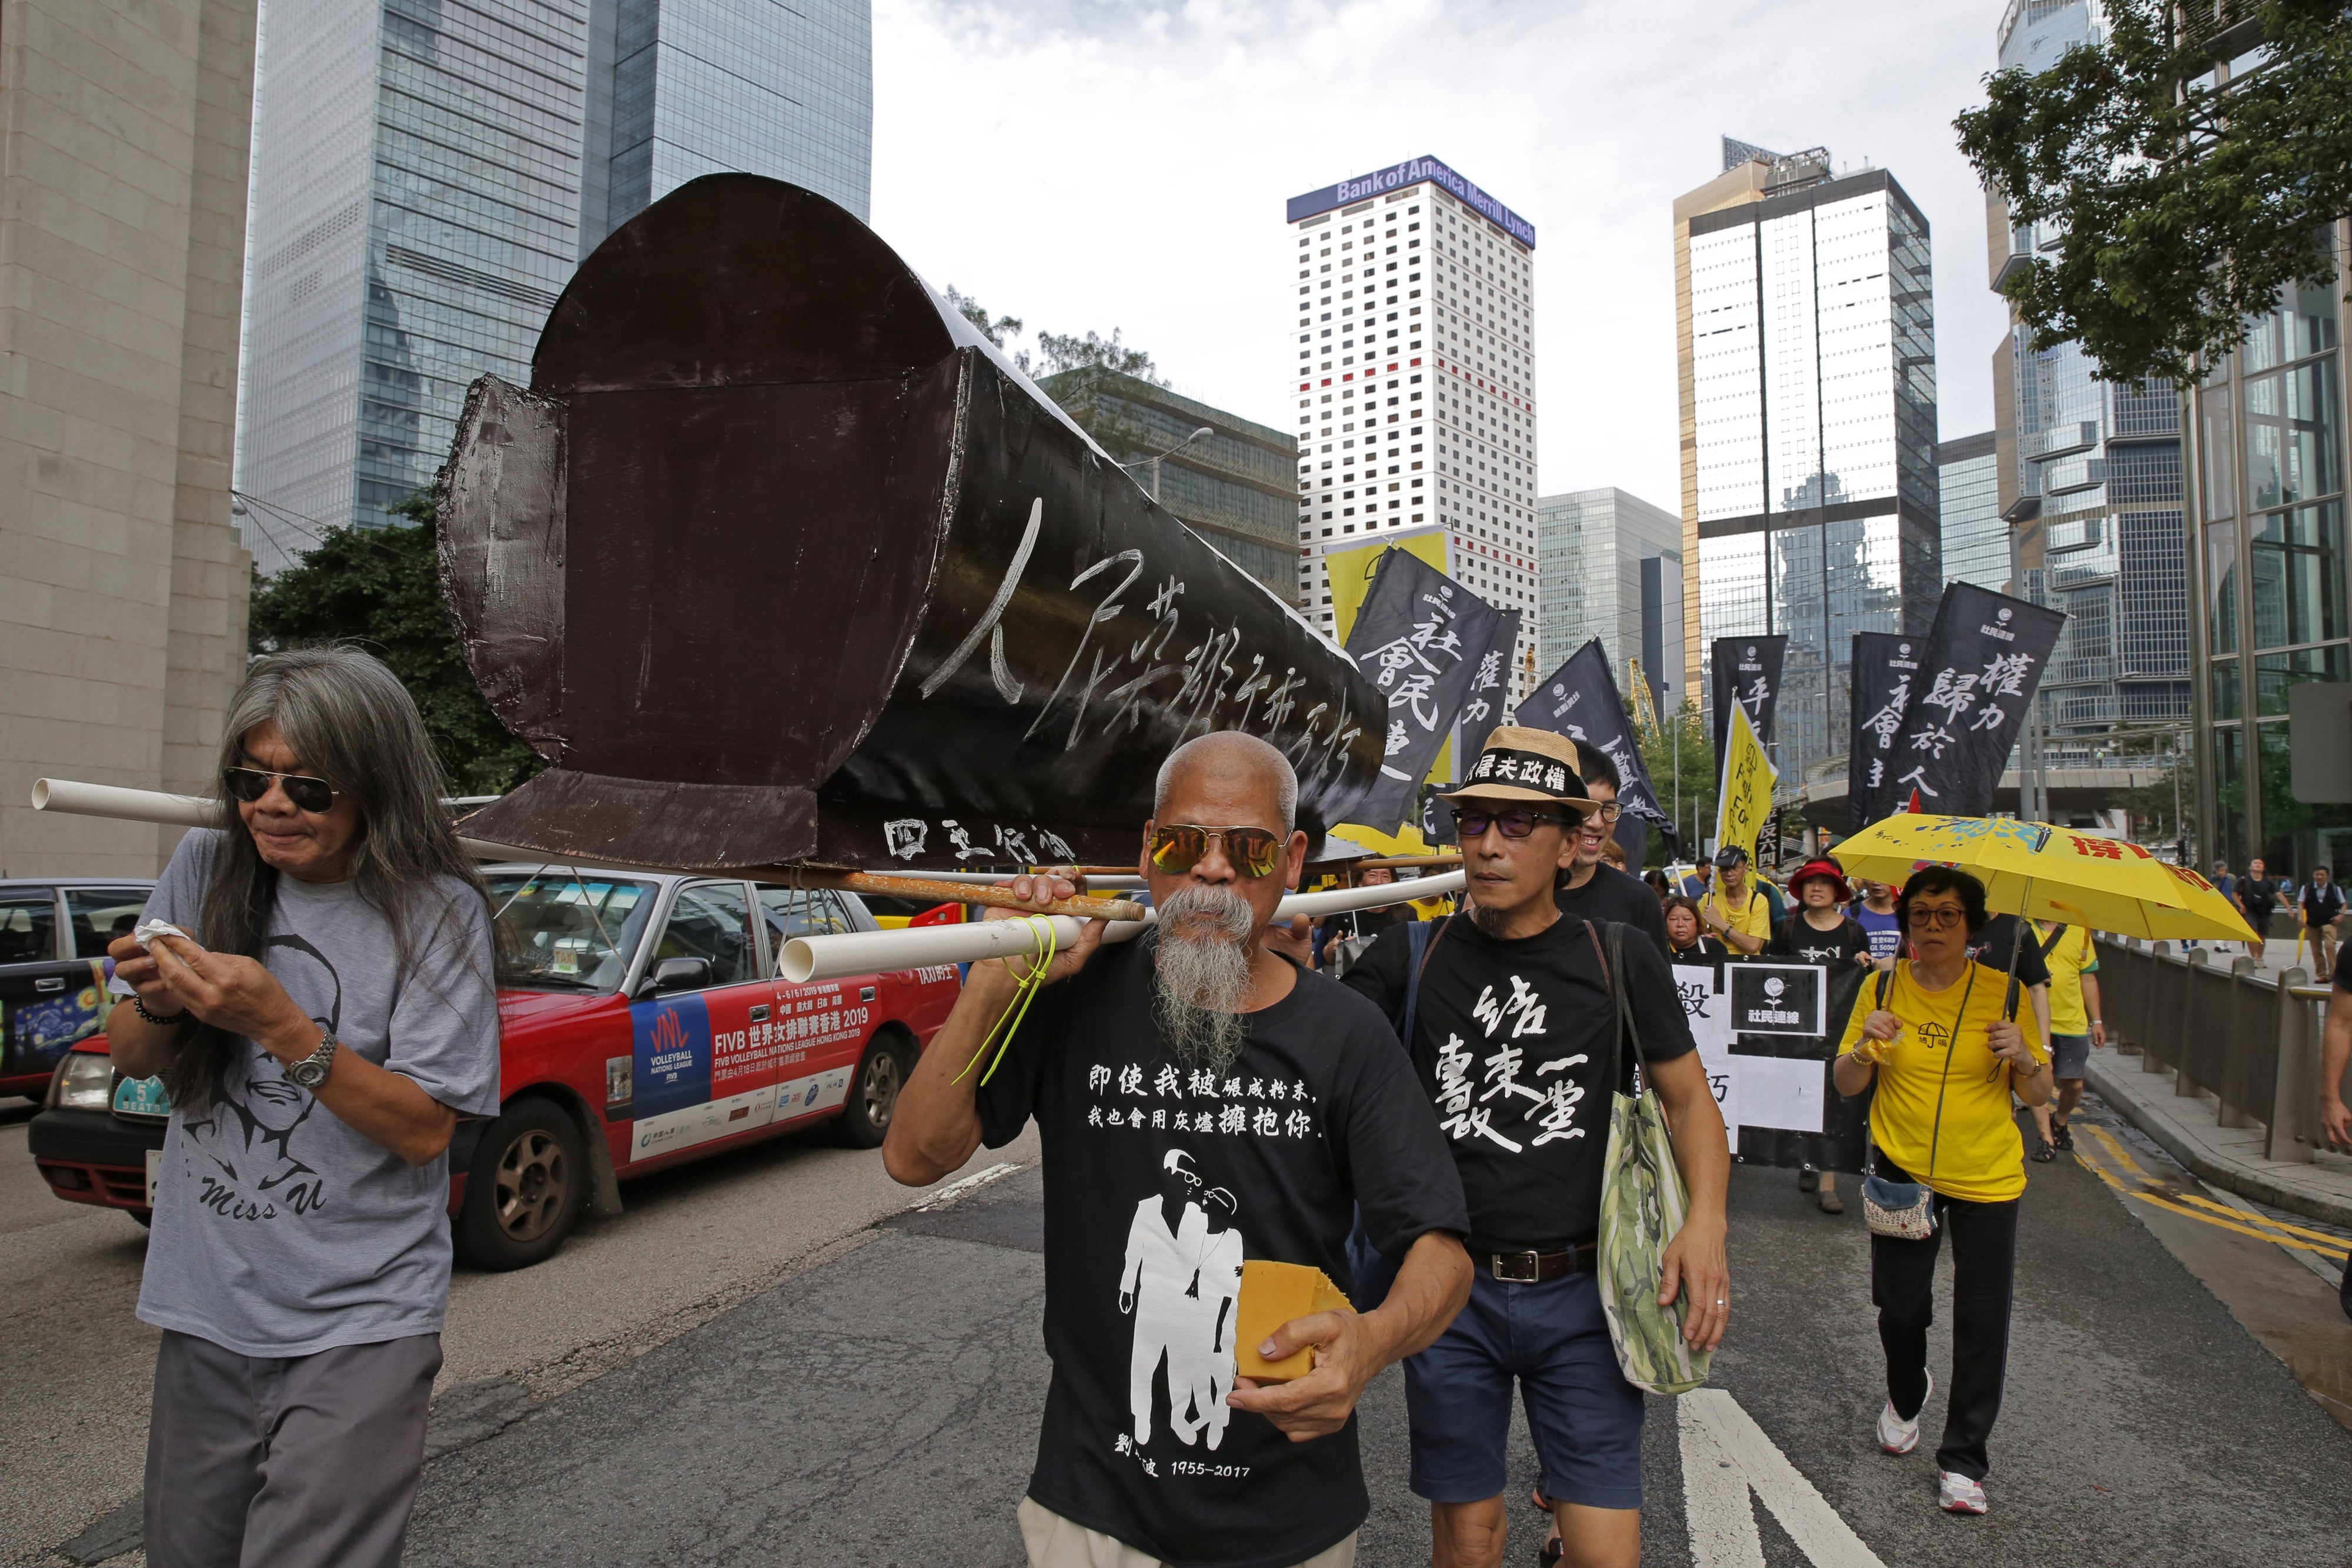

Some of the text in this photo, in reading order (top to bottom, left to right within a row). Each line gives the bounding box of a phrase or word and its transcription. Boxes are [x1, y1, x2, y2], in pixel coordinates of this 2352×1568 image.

[1337, 159, 1534, 245] Bank of America Merrill Lynch
[1980, 624, 2016, 641] 社民連線
[1463, 754, 1565, 792] 屠夫政權
[915, 966, 937, 985] TAXI
[1748, 1009, 1800, 1024] 社民連線
[715, 1006, 868, 1055] FIVB 世界女排聯賽香港 2019
[714, 1028, 860, 1068] FIVB VOLLEYBALL NATIONS LEAGUE HONG KONG 2019
[651, 1050, 692, 1066] VOLLEYBALL
[651, 1059, 692, 1074] NATIONS LEAGUE
[137, 1084, 146, 1102] 5
[122, 1101, 161, 1113] SEATS
[200, 1176, 278, 1221] Miss
[1115, 1432, 1159, 1477] 劉波
